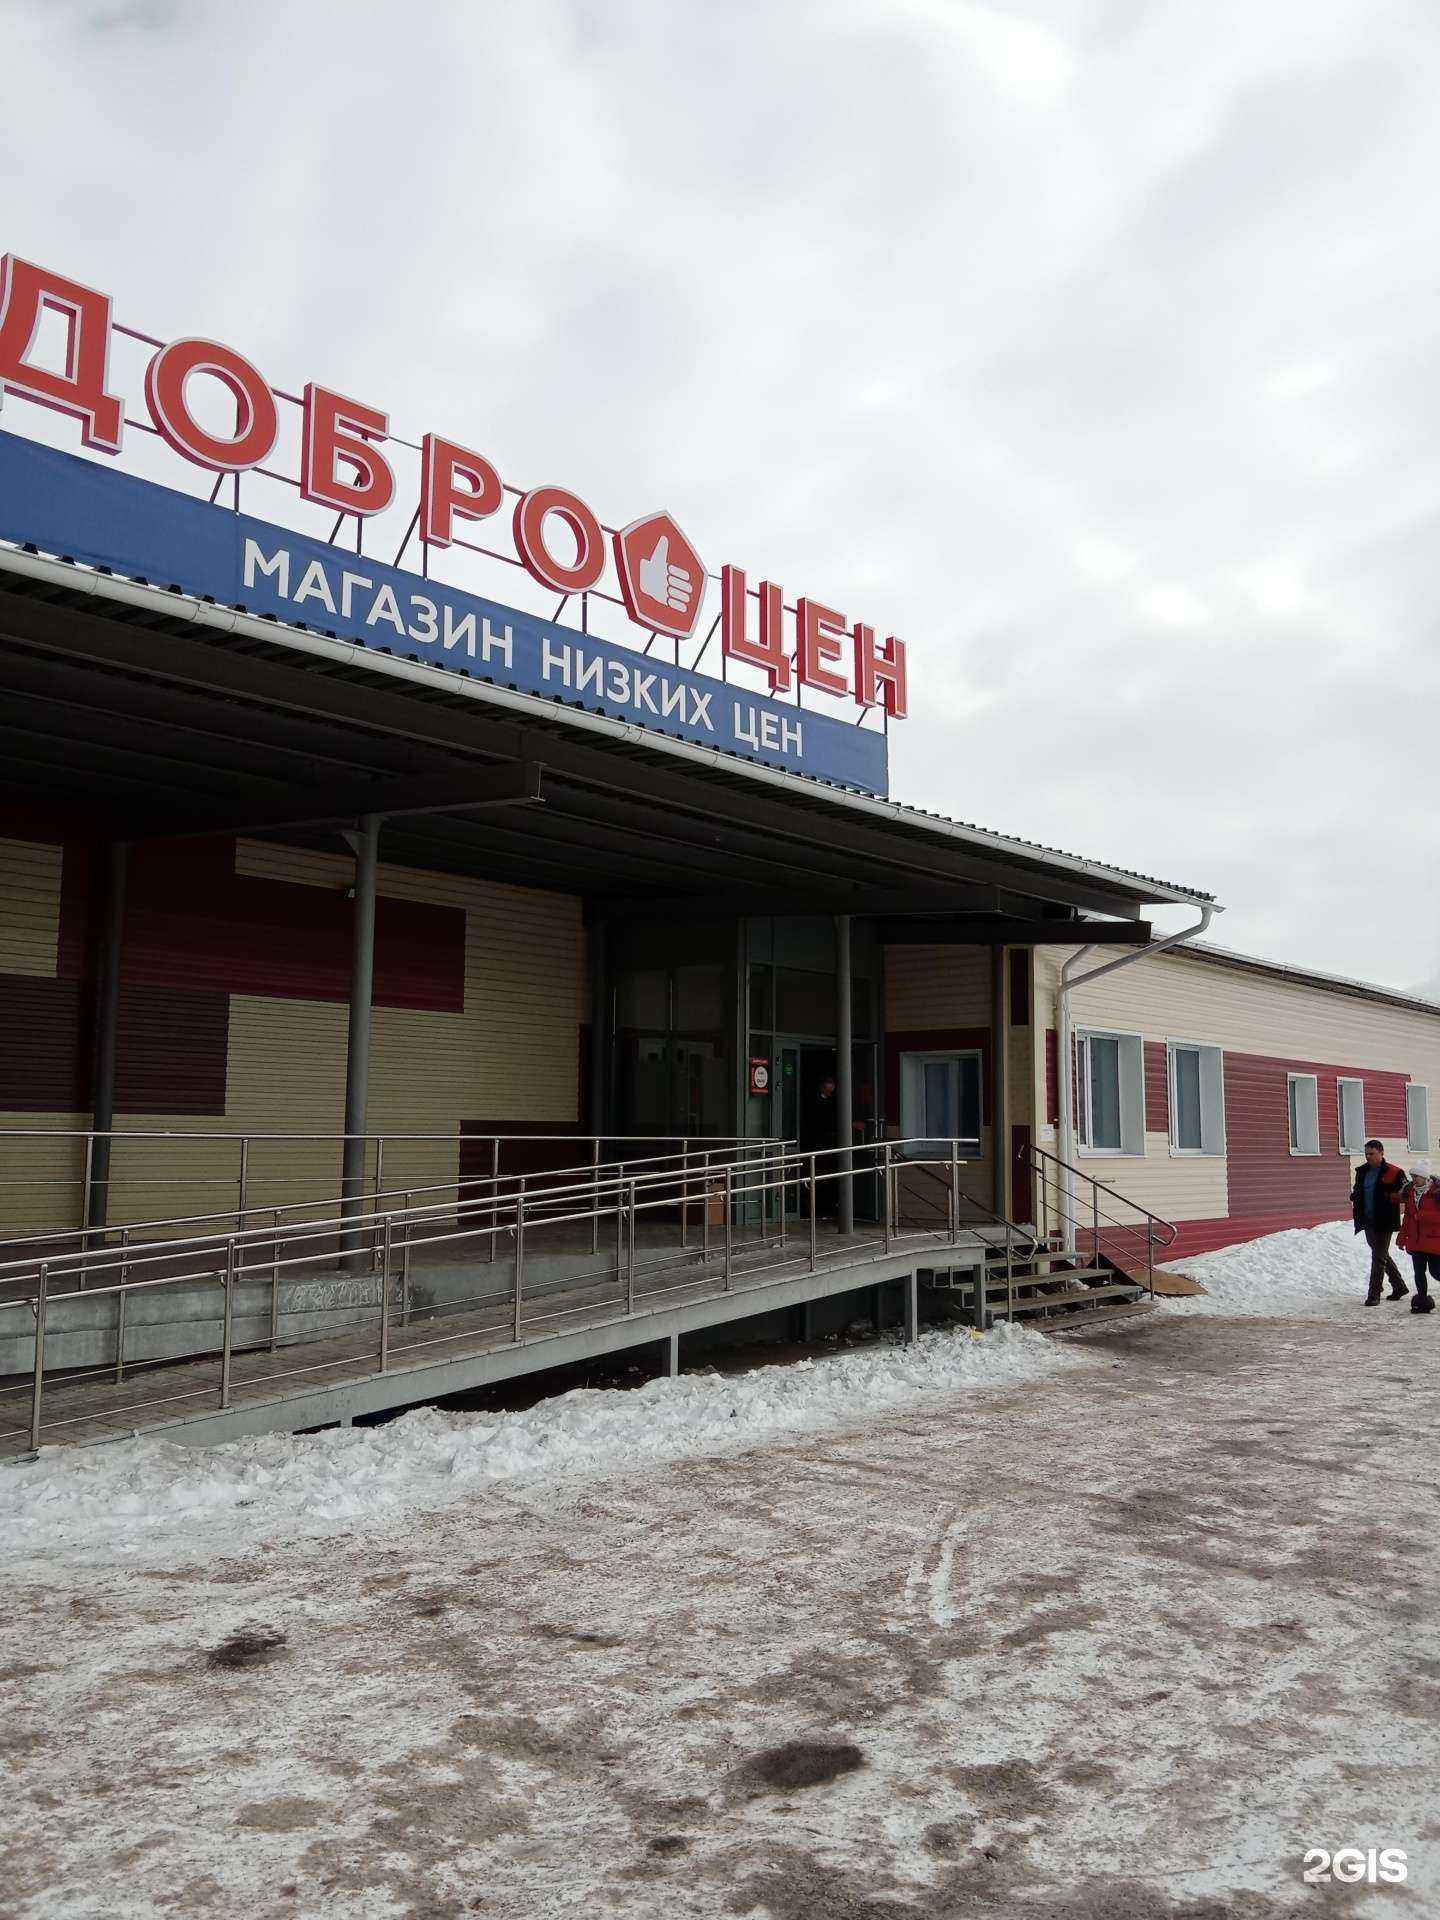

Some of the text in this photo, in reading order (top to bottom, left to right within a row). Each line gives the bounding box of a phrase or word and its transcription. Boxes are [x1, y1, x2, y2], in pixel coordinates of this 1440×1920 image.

[243, 537, 803, 758] МАГАЗИН НИЗКИХ ЦЕН
